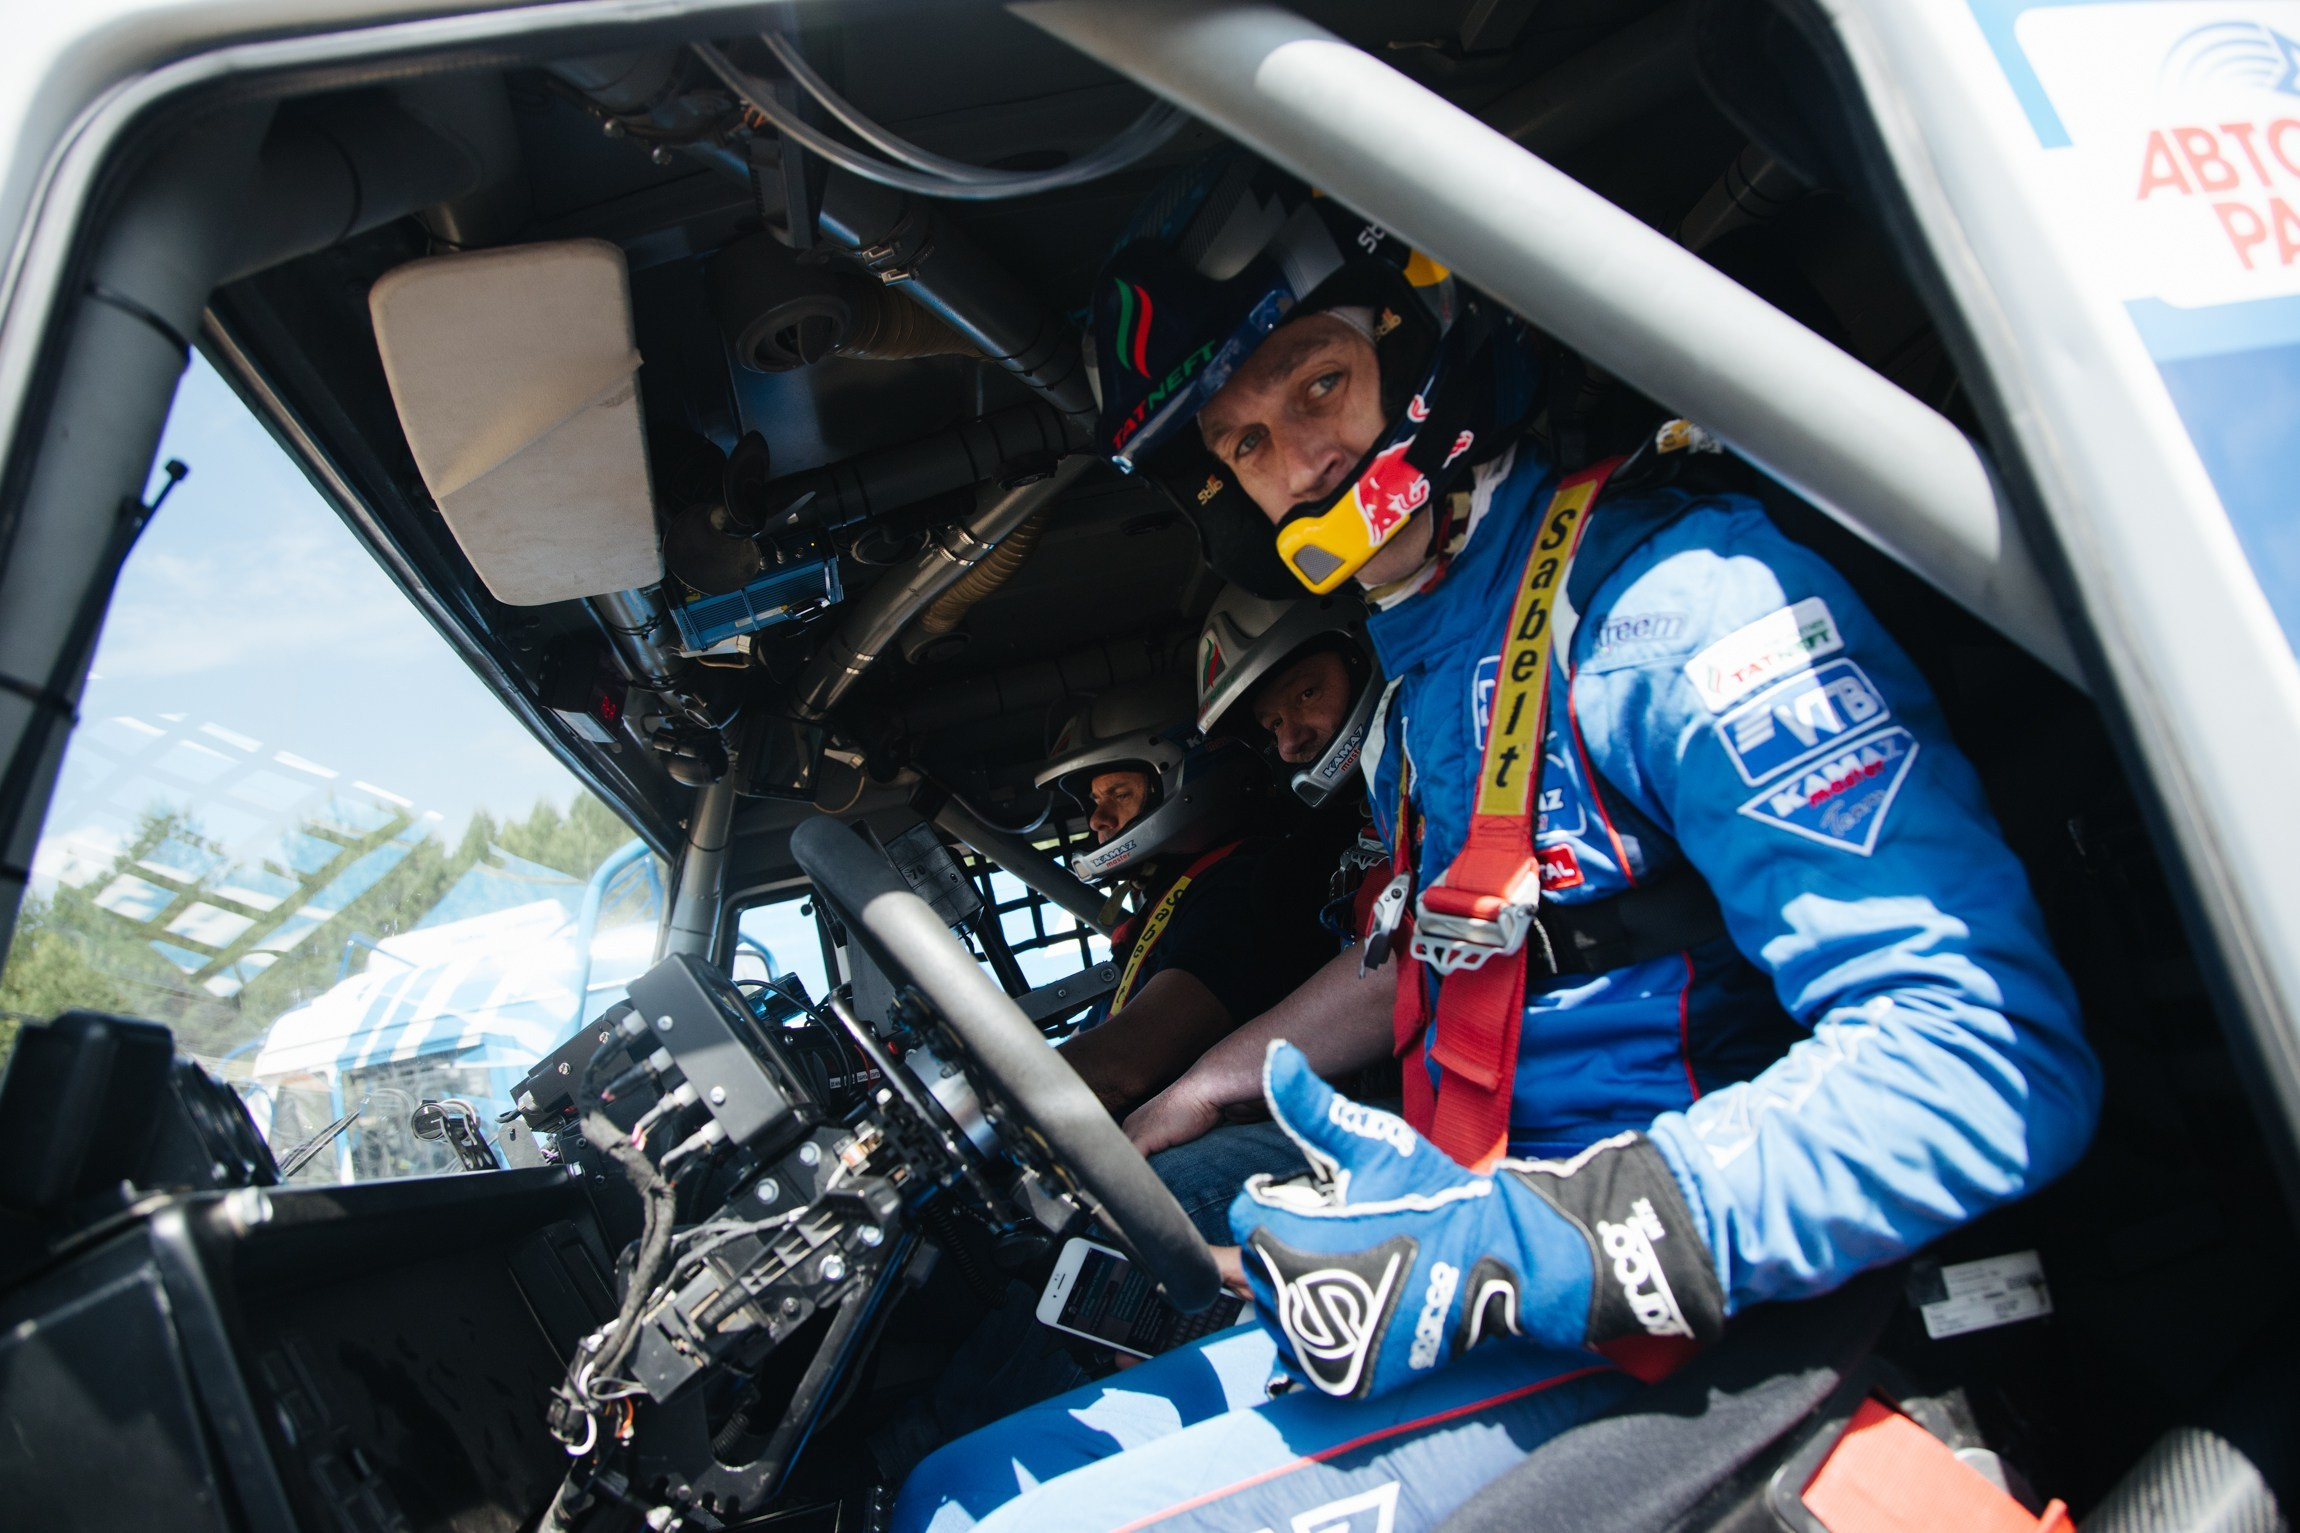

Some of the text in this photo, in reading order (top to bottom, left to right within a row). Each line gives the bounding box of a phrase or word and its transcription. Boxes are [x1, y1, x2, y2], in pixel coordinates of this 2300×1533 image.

[1112, 339, 1217, 451] TATNEFT
[1495, 508, 1577, 788] Sabelt
[1322, 722, 1363, 779] KAMAZ
[1340, 745, 1361, 772] mast
[1092, 839, 1137, 867] KAMAZ
